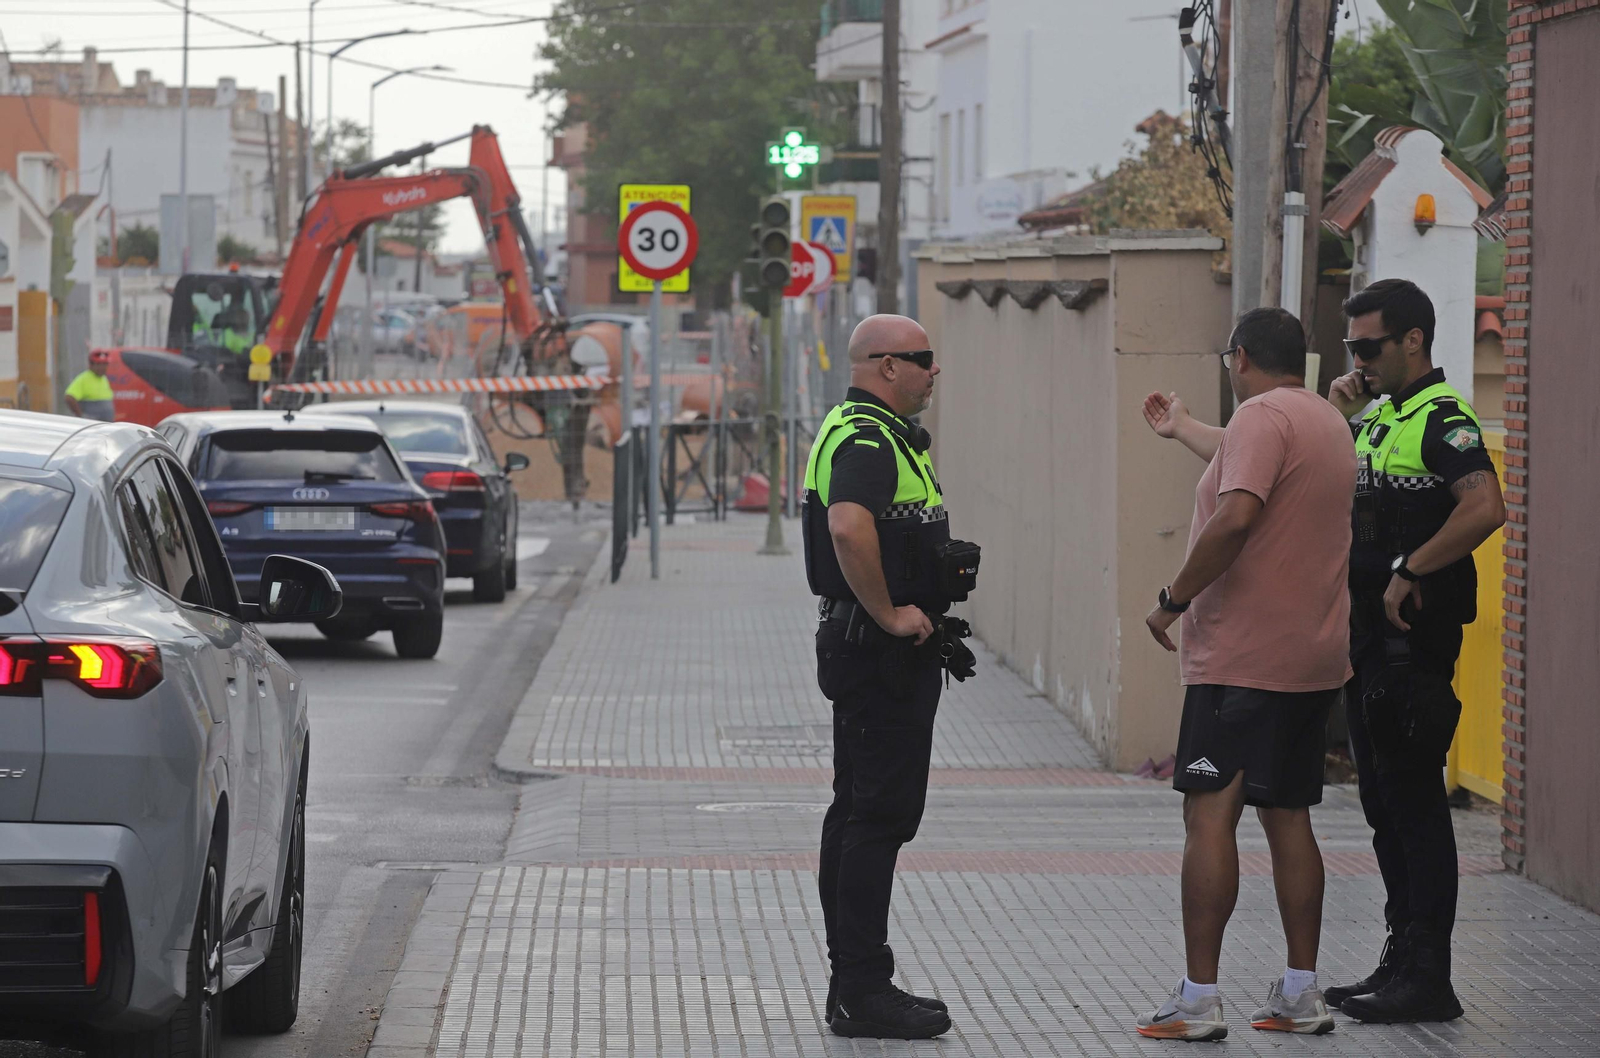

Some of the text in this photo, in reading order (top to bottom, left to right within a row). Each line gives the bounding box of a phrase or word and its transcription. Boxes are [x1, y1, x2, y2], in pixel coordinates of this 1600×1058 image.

[624, 190, 687, 199] ATENCIÓN
[638, 227, 679, 252] 30
[790, 261, 815, 278] OP
[1202, 770, 1219, 778] TRAIL
